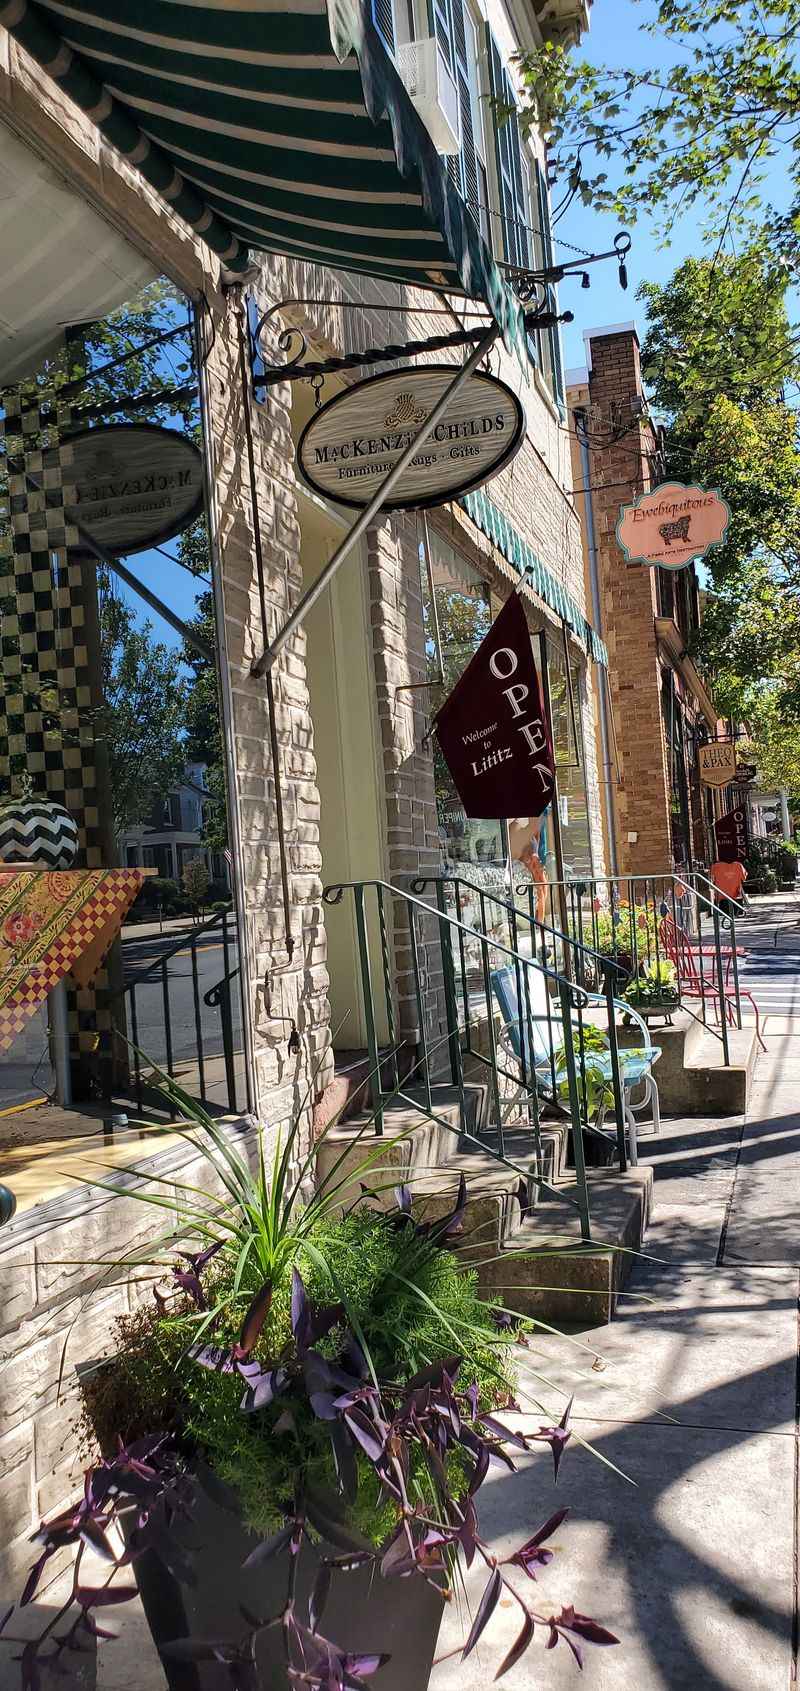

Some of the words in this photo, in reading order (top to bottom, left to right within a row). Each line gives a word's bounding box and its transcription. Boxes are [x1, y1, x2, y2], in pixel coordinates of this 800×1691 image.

[449, 445, 481, 460] Gifts
[489, 647, 554, 793] OPEN
[461, 721, 499, 745] Welcome
[483, 740, 492, 750] to
[470, 746, 513, 777] Lititz
[703, 748, 732, 759] THEO
[734, 811, 747, 857] OPEN
